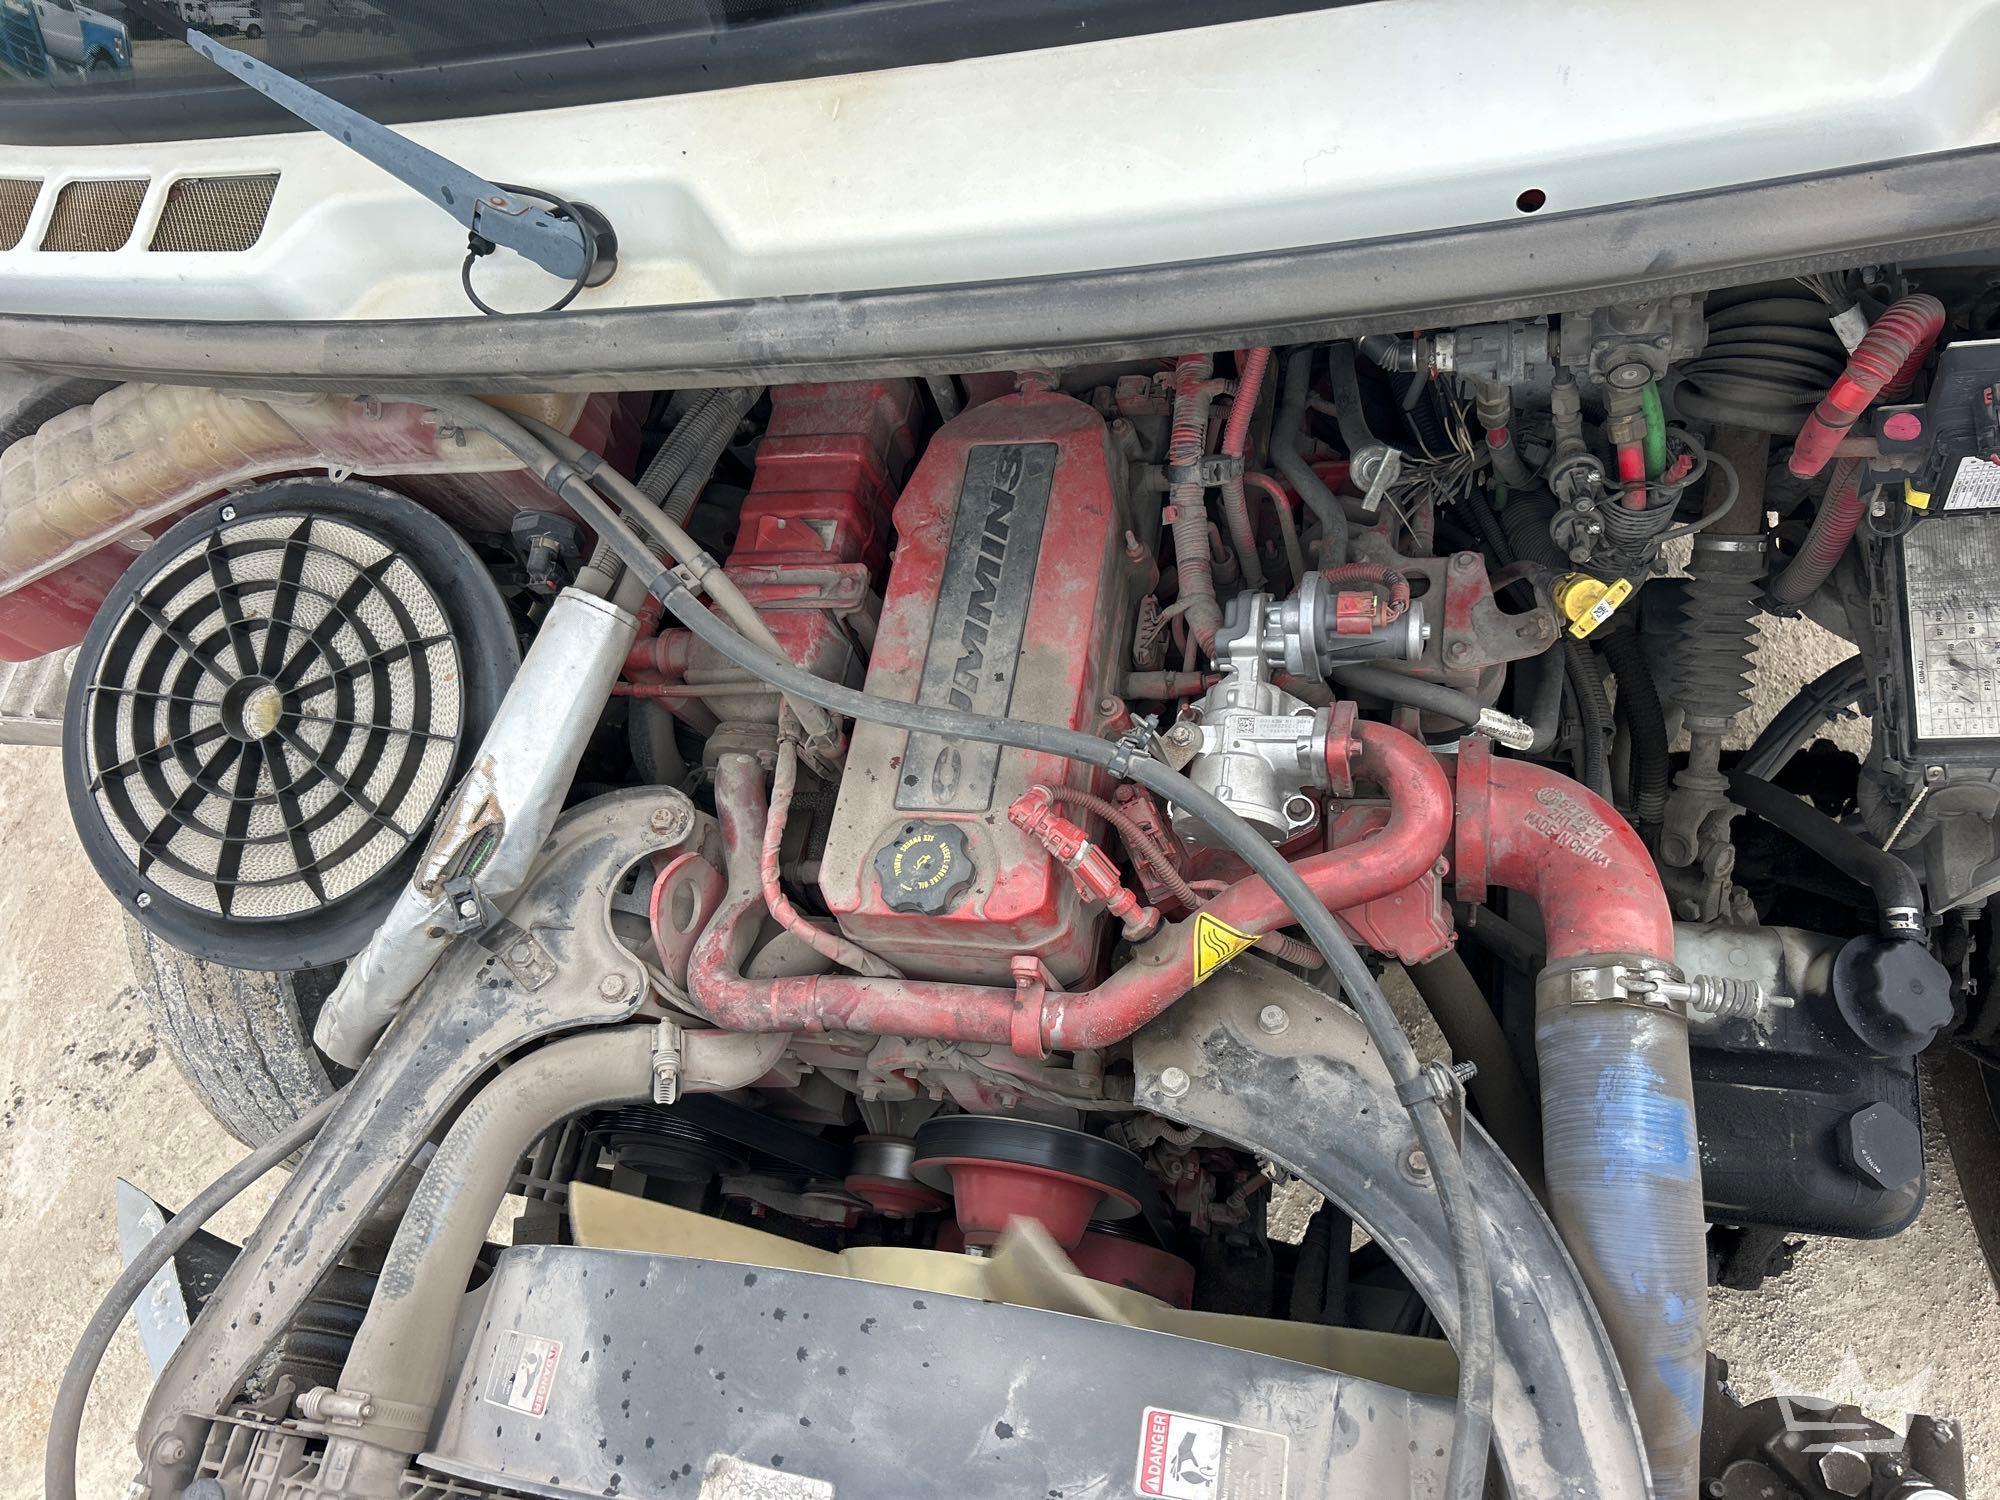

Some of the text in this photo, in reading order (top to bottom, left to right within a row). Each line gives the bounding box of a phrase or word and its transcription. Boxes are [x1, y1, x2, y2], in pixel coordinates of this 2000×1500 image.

[1569, 839, 1609, 866] CHINA
[533, 1360, 554, 1414] DANGER
[1148, 1414, 1167, 1480] DANGER
